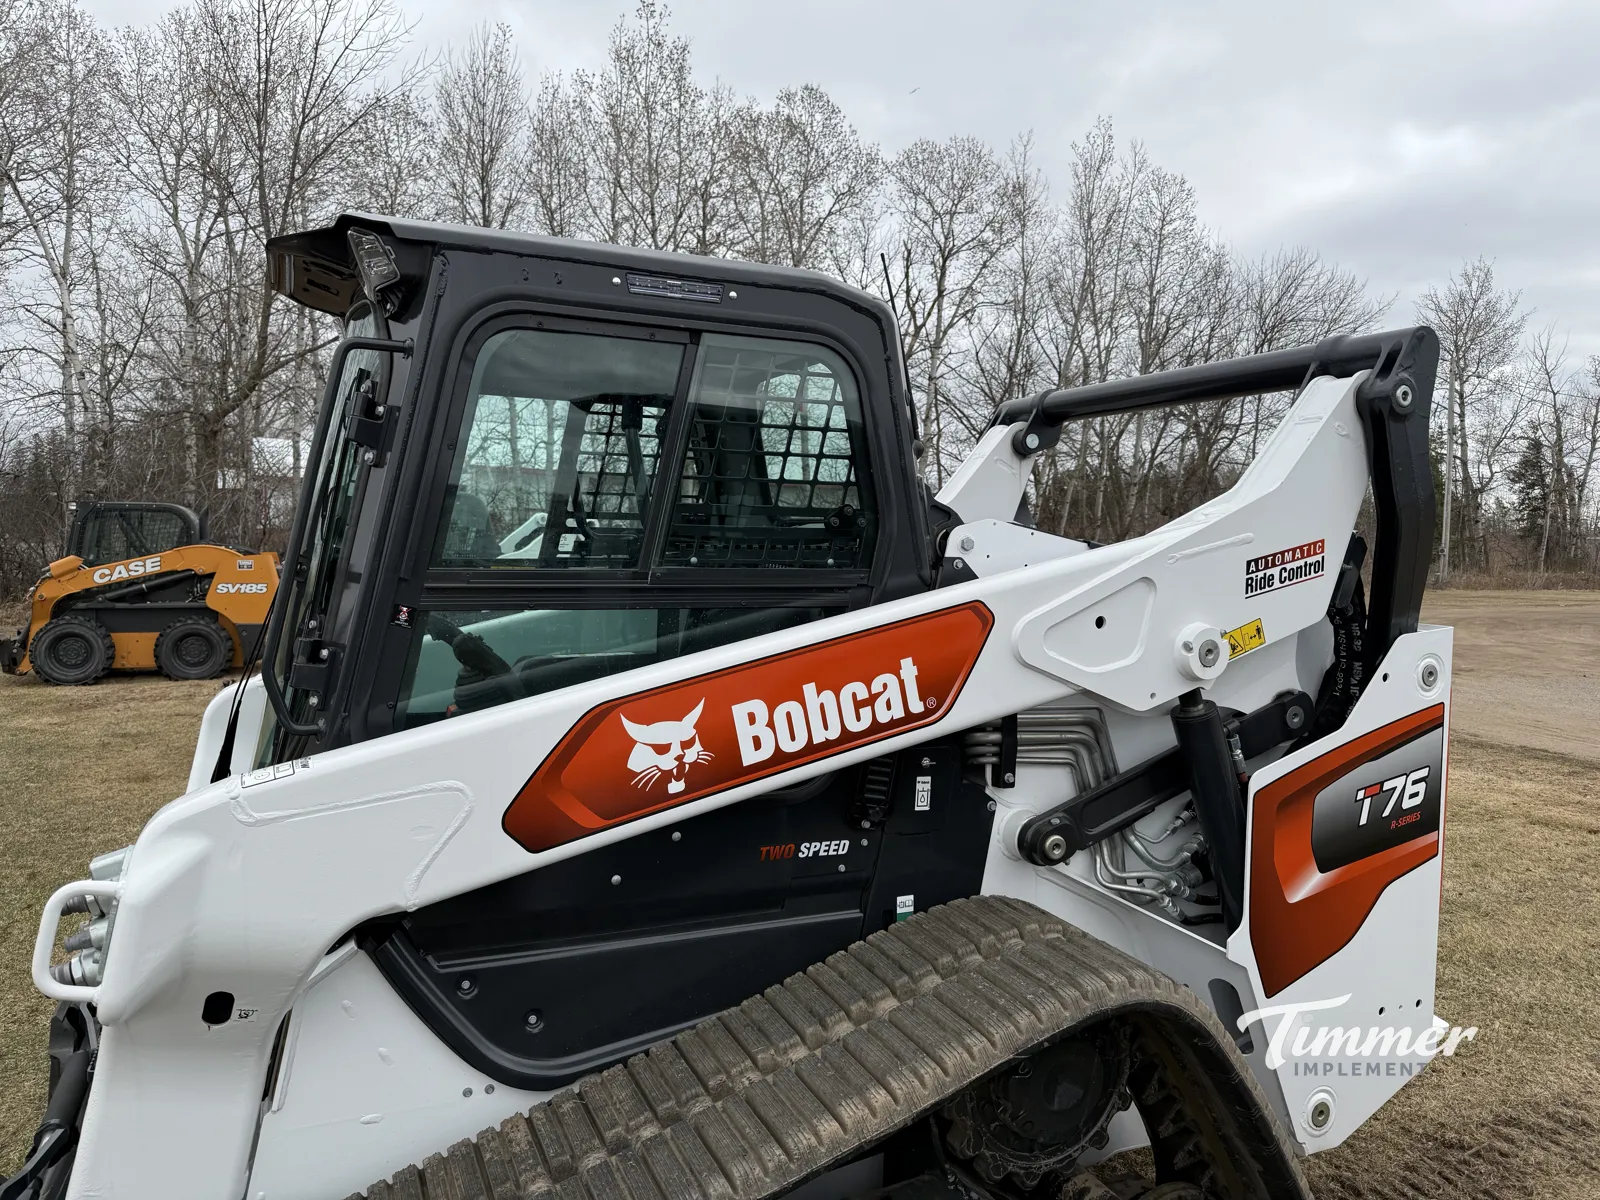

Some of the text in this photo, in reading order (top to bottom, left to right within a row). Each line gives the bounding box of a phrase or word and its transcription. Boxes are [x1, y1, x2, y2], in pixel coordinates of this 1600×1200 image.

[93, 556, 161, 584] CASE
[1249, 542, 1323, 573] AUTOMATIC
[215, 583, 268, 594] SV185
[1245, 556, 1324, 595] Ride Control
[731, 657, 925, 767] Bobcat
[1355, 765, 1430, 828] T76
[1390, 811, 1421, 829] R-SERIES
[760, 840, 850, 861] TWO SPEED
